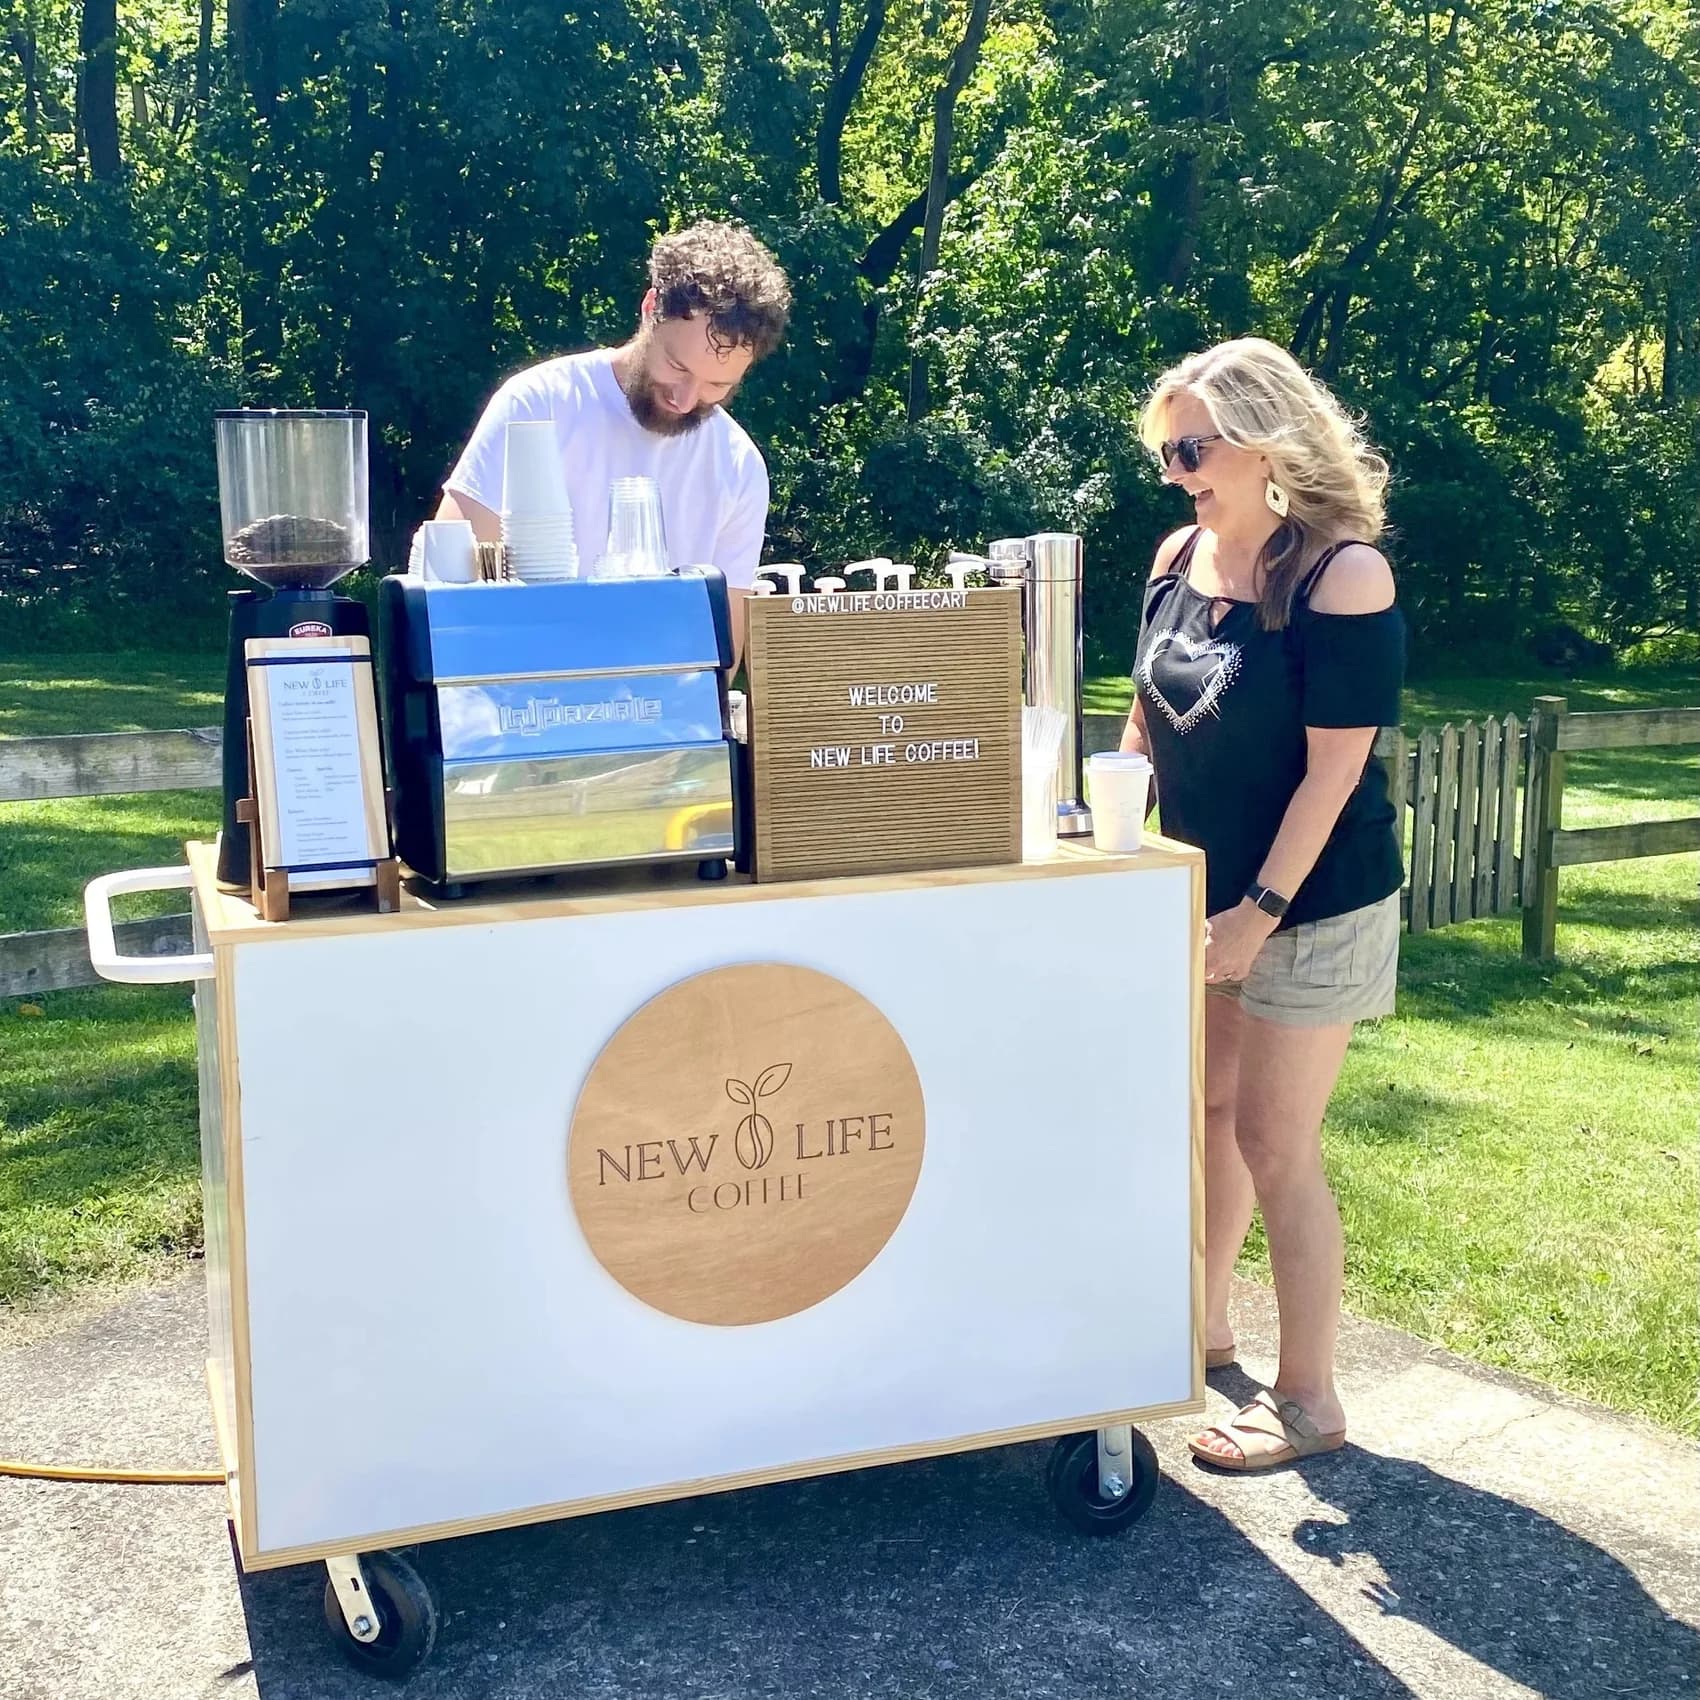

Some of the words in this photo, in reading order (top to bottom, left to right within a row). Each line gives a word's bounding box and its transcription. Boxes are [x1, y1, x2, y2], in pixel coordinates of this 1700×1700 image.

[294, 624, 327, 635] EUREKA
[283, 680, 310, 689] NEW
[325, 679, 348, 688] LIFE
[849, 683, 938, 706] WELCOME
[879, 715, 904, 734] TO
[810, 747, 850, 768] NEW
[861, 744, 896, 765] LIFE
[906, 738, 980, 762] COFFEE!
[597, 1134, 719, 1186] NEW
[796, 1113, 895, 1160] LIFE
[688, 1173, 811, 1214] COFFEE
